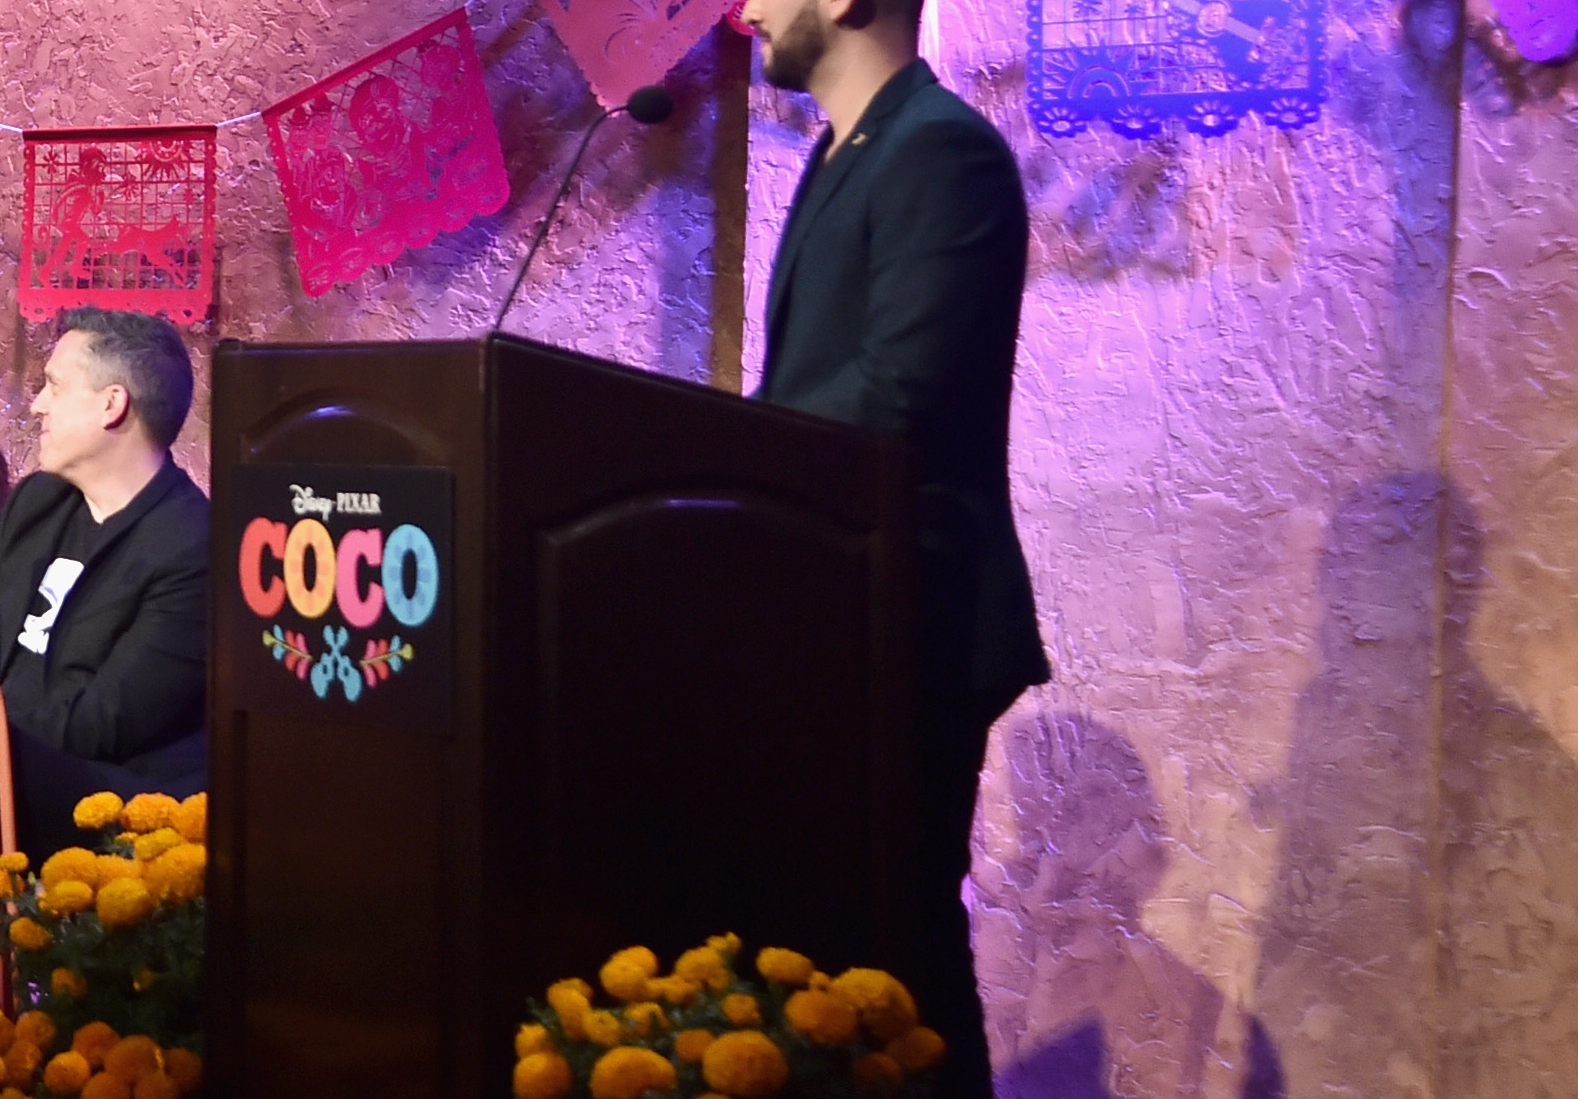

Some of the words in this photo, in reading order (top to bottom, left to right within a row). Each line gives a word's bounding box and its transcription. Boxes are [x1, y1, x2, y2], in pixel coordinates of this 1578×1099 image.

[289, 484, 332, 521] Disney
[336, 492, 382, 514] PIXAR
[238, 516, 439, 628] COCO
